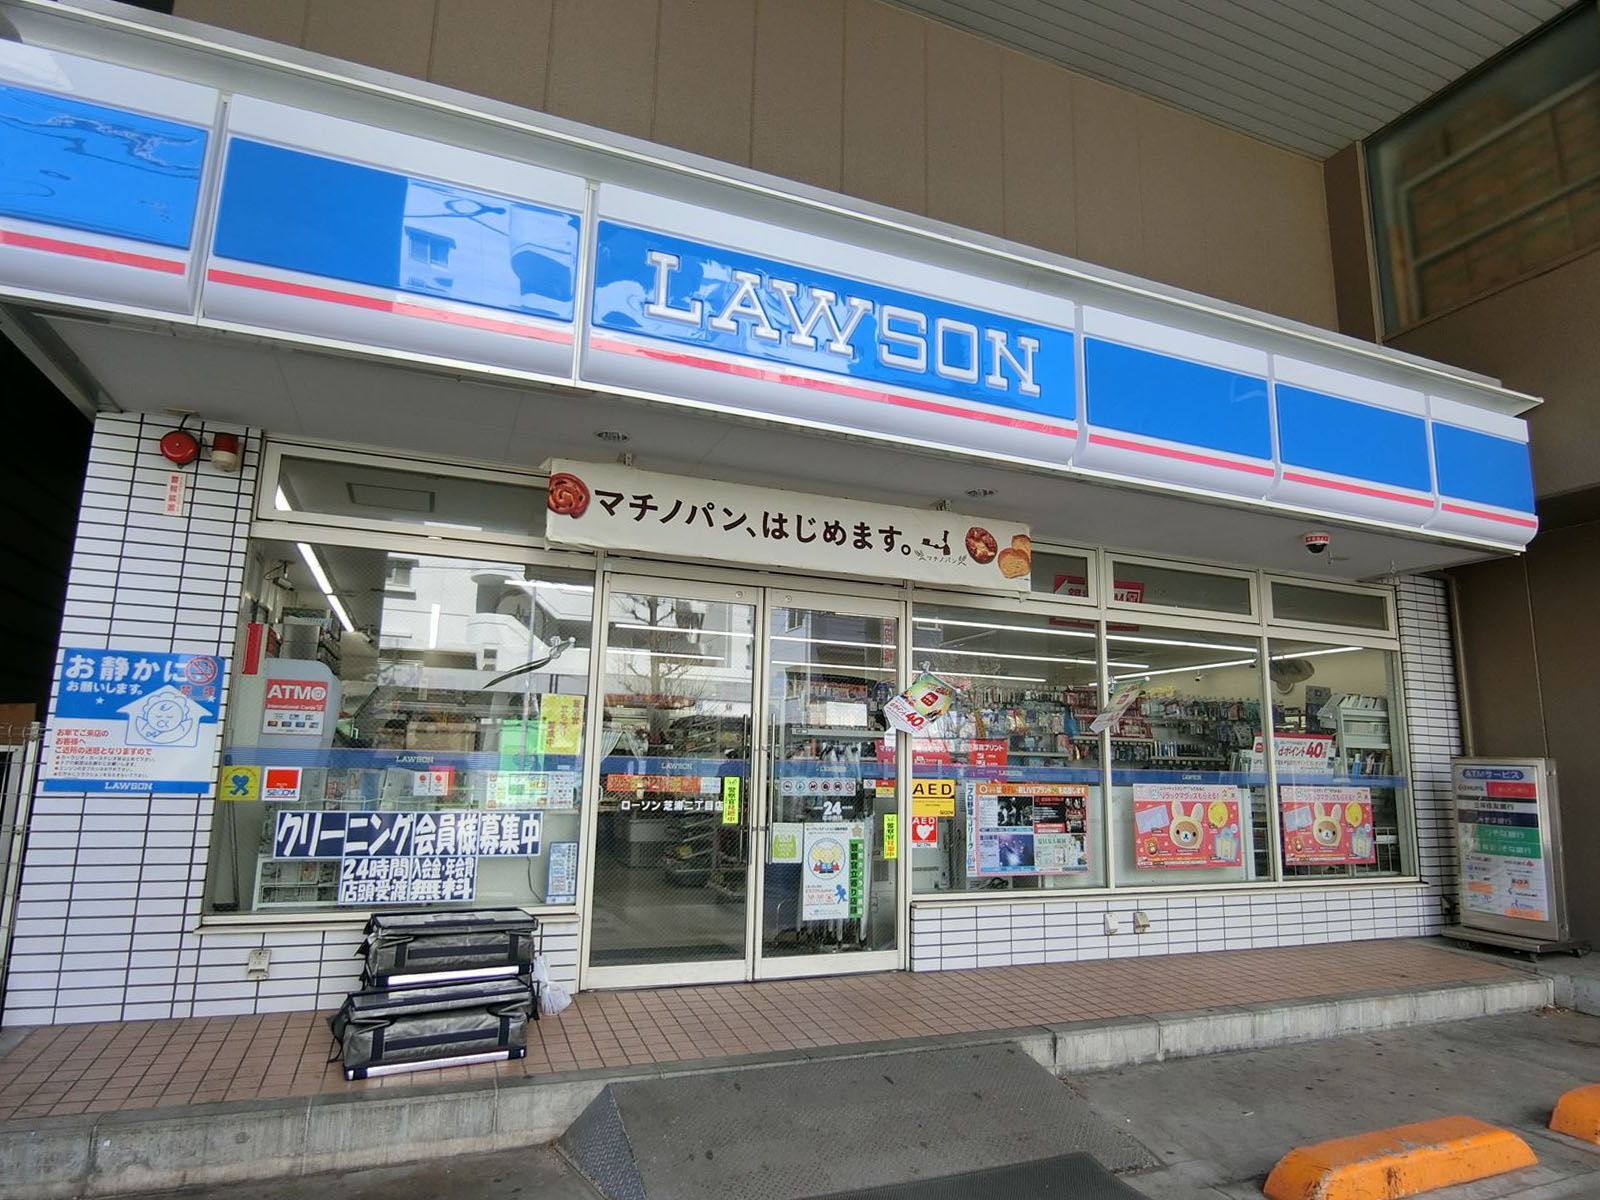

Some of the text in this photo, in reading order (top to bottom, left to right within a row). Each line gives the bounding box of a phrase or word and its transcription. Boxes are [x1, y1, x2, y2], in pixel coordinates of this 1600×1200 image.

[644, 250, 1041, 398] LAWSON
[595, 488, 912, 556] マチノパン、はじめます。
[66, 655, 187, 682] お静かに
[66, 681, 143, 695] お願いします。
[905, 711, 925, 728] 40
[55, 738, 86, 746] お客様へ
[1306, 742, 1324, 758] 40
[396, 755, 434, 763] LAWSON
[1465, 769, 1521, 779] ATMサービス
[104, 781, 153, 791] LAWSON
[912, 783, 952, 795] AED
[621, 800, 724, 811] ローソン 芝浦二丁目店
[823, 801, 842, 815] 24
[277, 813, 540, 857] クリーニング会員様募集中
[342, 857, 475, 880] 24時間 入会金・年会費
[342, 879, 472, 902] 店頭受渡 無料
